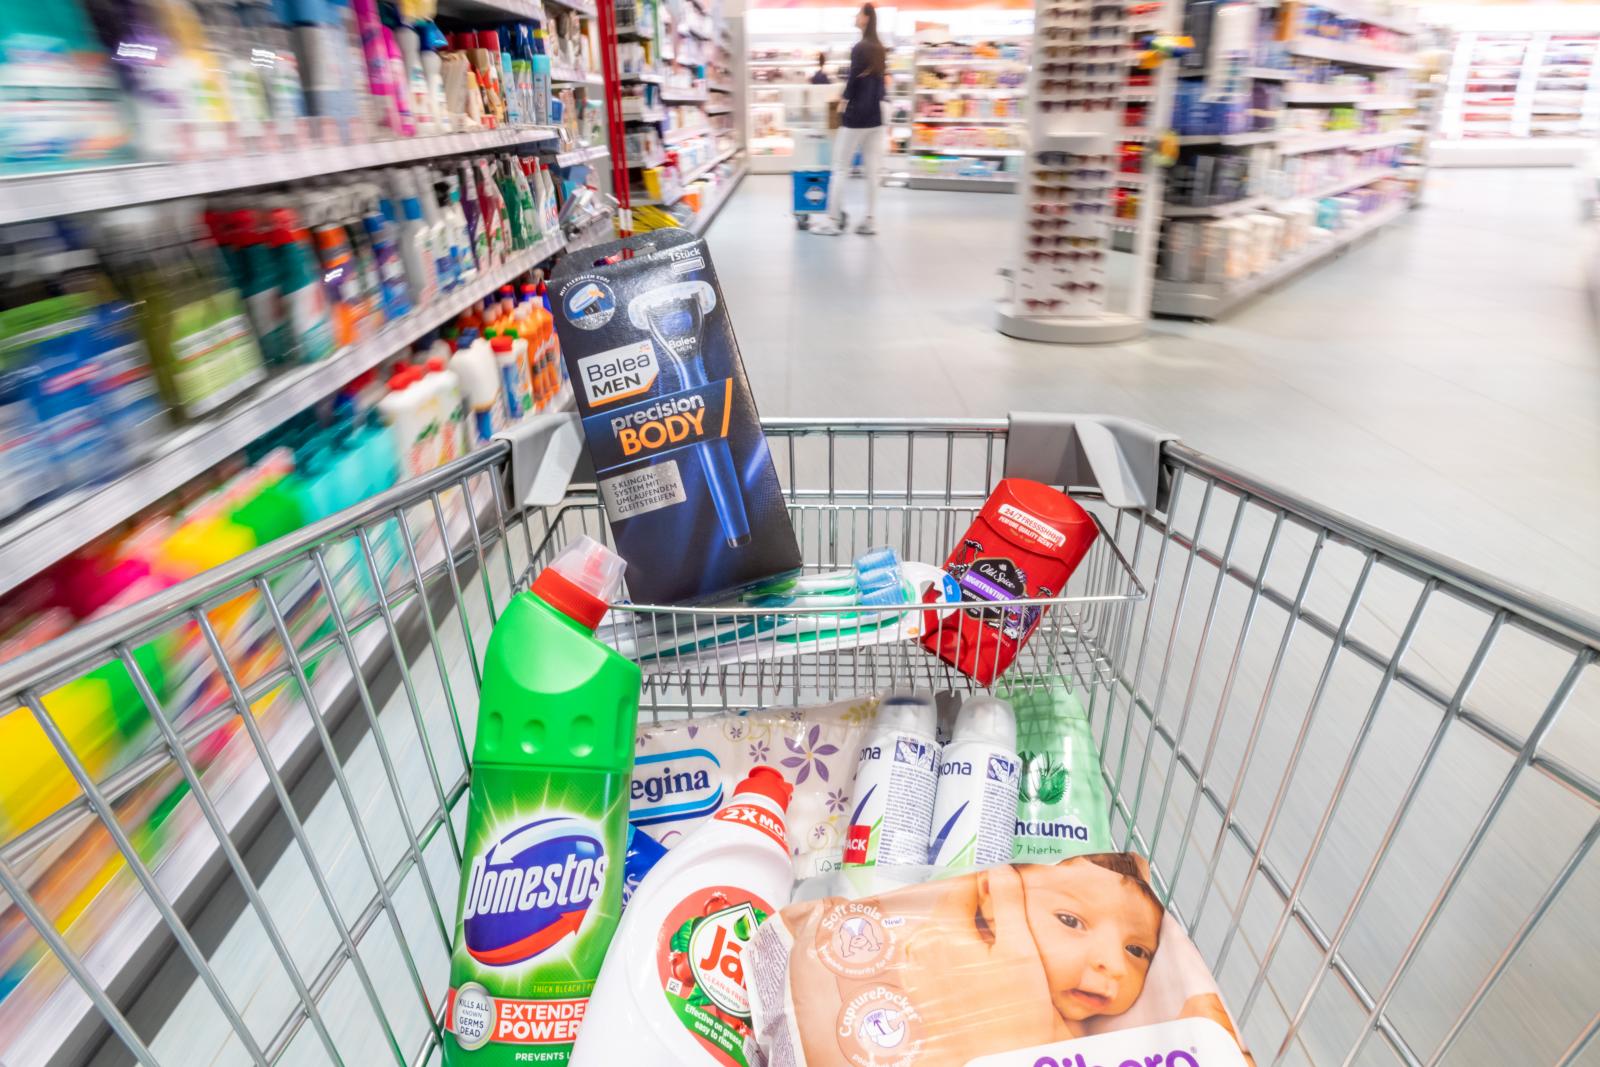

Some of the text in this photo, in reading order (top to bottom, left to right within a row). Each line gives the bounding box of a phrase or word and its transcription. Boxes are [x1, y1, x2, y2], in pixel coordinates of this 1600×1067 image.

[668, 336, 696, 348] Balea
[586, 353, 651, 382] Balea
[591, 372, 642, 398] MEN
[610, 394, 706, 439] precision
[619, 407, 706, 456] BODY
[611, 483, 618, 491] 5
[614, 479, 661, 498] SYSTEM MIT
[616, 482, 678, 506] UMLAUFENDEM
[618, 491, 676, 513] GLEITSTREIFEN
[979, 563, 1013, 590] Old Spice
[722, 808, 786, 842] 2X MO
[1016, 844, 1024, 855] 7
[463, 853, 610, 921] Domestos
[822, 903, 882, 930] Soft seals
[699, 924, 748, 992] Ja
[458, 998, 489, 1012] KILLS ALL
[462, 1009, 483, 1018] KNOWN
[459, 1016, 484, 1029] GERMS
[684, 1003, 714, 1026] Effective
[714, 1022, 723, 1032] on
[460, 1026, 481, 1038] DEAD
[498, 1020, 580, 1040] POWER
[694, 1020, 734, 1052] easy to rinse
[515, 1051, 564, 1062] PREVENTS
